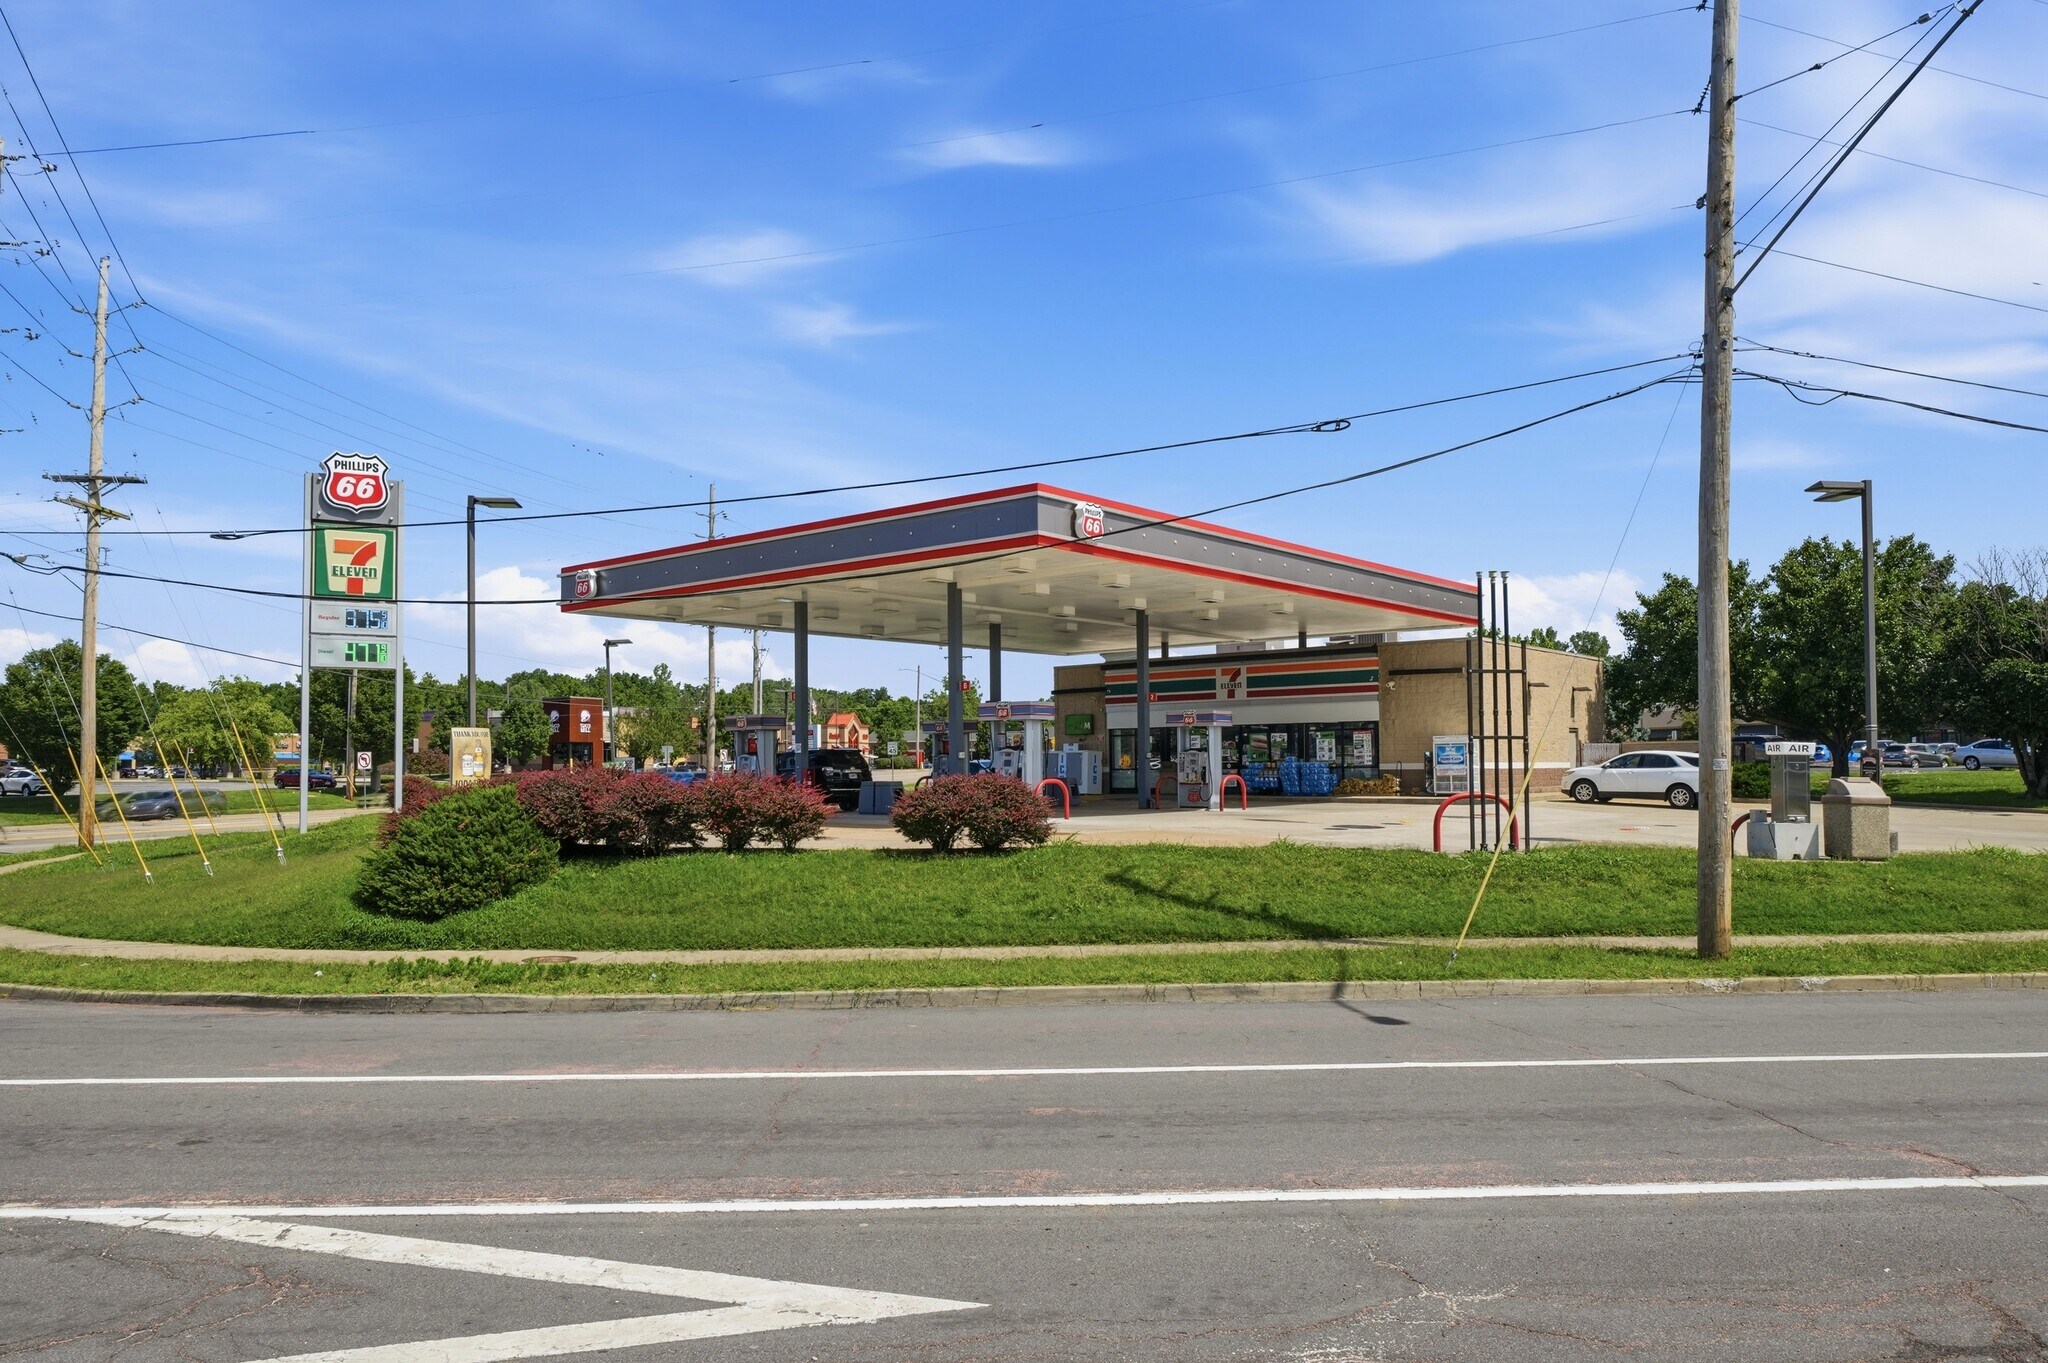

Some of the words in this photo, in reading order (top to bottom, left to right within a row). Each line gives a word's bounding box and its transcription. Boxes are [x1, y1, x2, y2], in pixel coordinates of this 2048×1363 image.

[334, 460, 379, 473] PHILLIPS
[336, 476, 376, 499] 66
[1086, 519, 1101, 534] 66
[333, 538, 377, 594] 7
[577, 582, 588, 594] 66
[1220, 667, 1242, 699] 7
[1767, 744, 1781, 753] AIR
[1789, 744, 1810, 753] AIR
